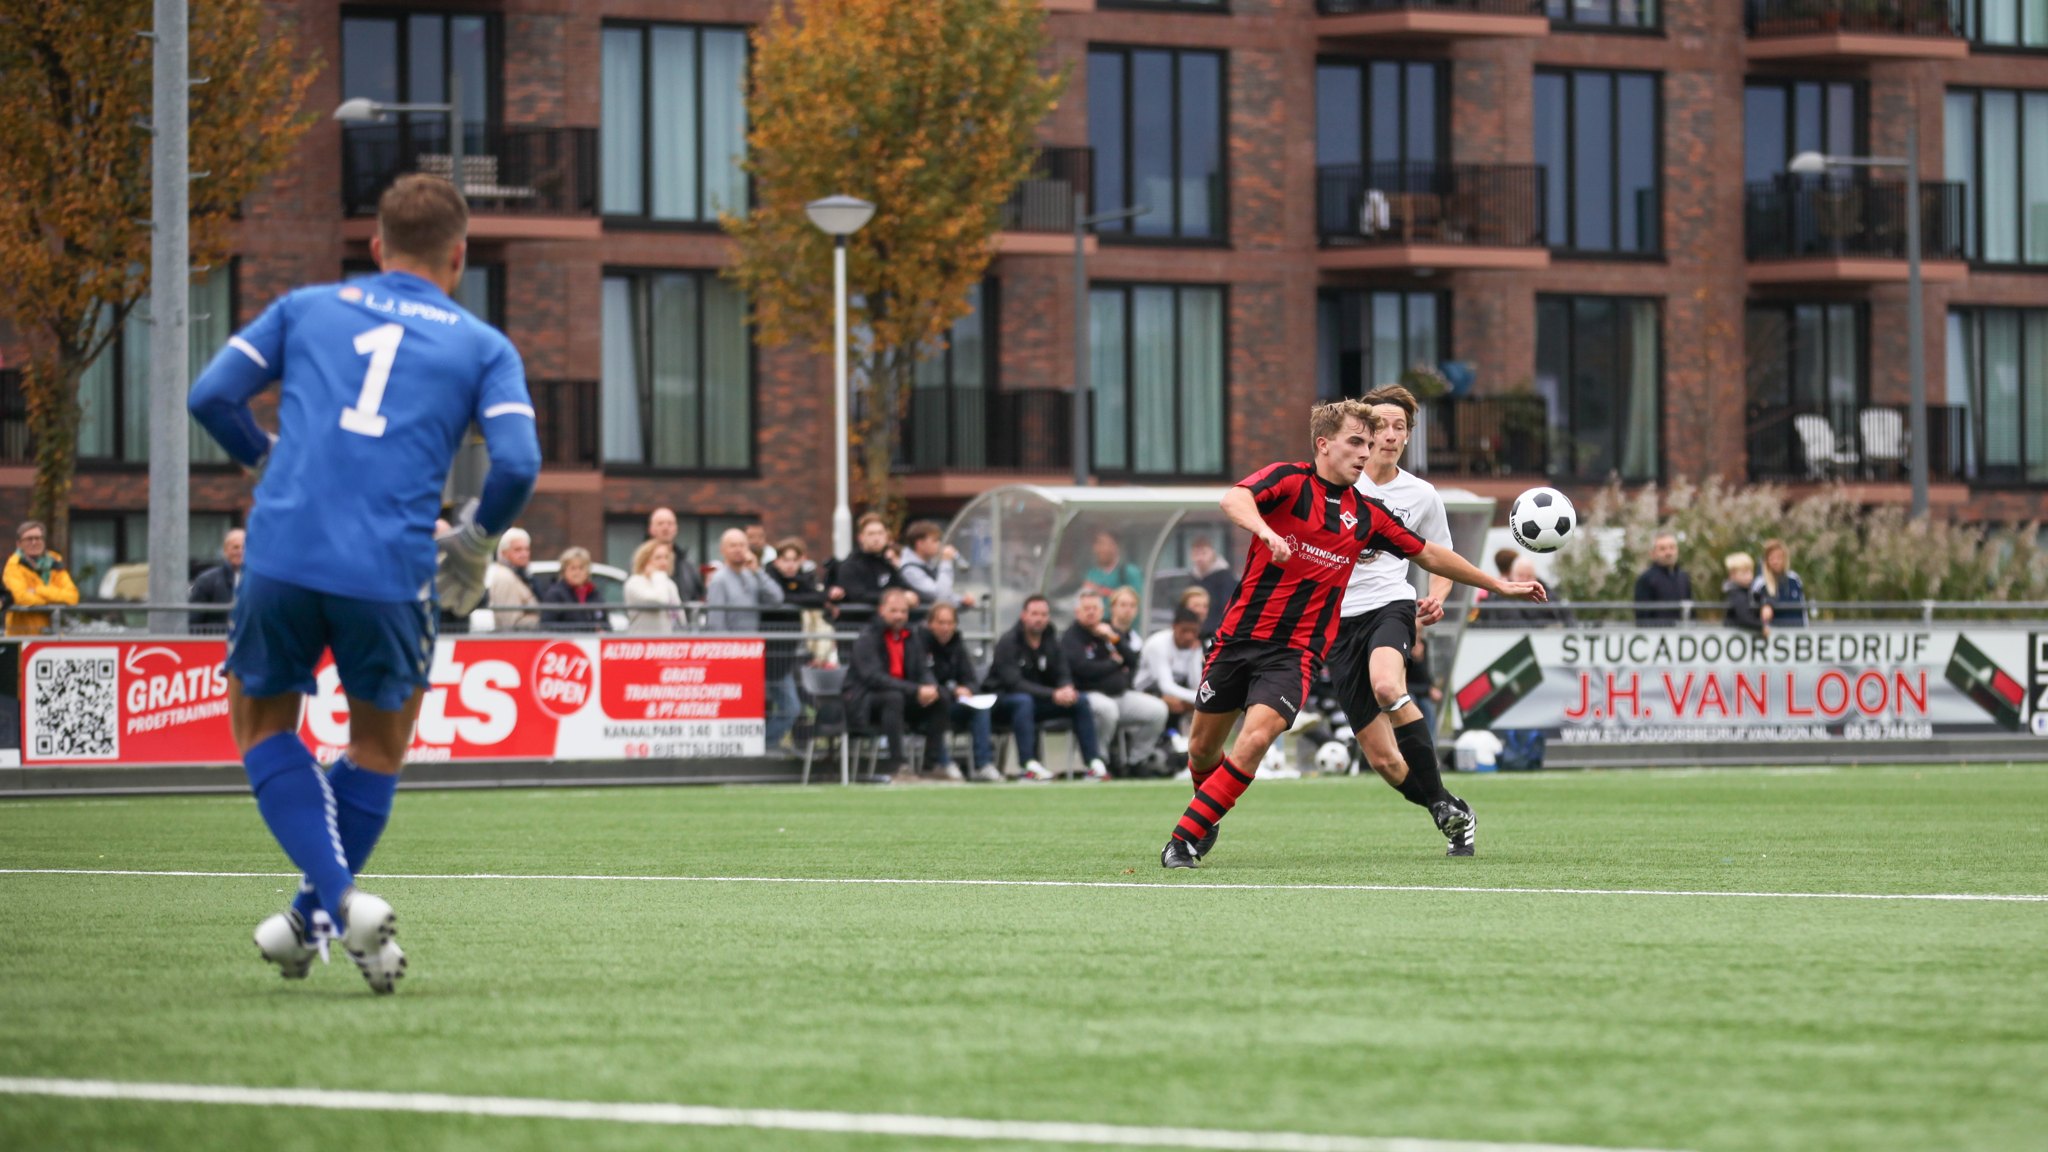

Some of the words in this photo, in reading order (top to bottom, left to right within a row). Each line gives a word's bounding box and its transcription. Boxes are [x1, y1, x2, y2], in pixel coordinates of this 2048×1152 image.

[398, 300, 461, 326] SPORT
[338, 322, 405, 438] 1
[603, 641, 645, 660] ALTIJD
[644, 641, 691, 660] DIRECT
[690, 640, 765, 660] OPZEGBAAR
[1562, 634, 1931, 664] STUCADOORSBEDRIJF
[541, 652, 590, 681] 24/7
[660, 666, 707, 684] GRATIS
[126, 664, 229, 714] GRATIS
[539, 677, 588, 706] OPEN
[624, 683, 743, 701] TRAININGSSCHEMA
[1564, 671, 1654, 719] J.H.
[1661, 671, 1768, 718] VAN
[1785, 670, 1929, 718] LOON
[127, 697, 229, 736] PROEFTRAINING
[720, 723, 765, 738] LEIDEN
